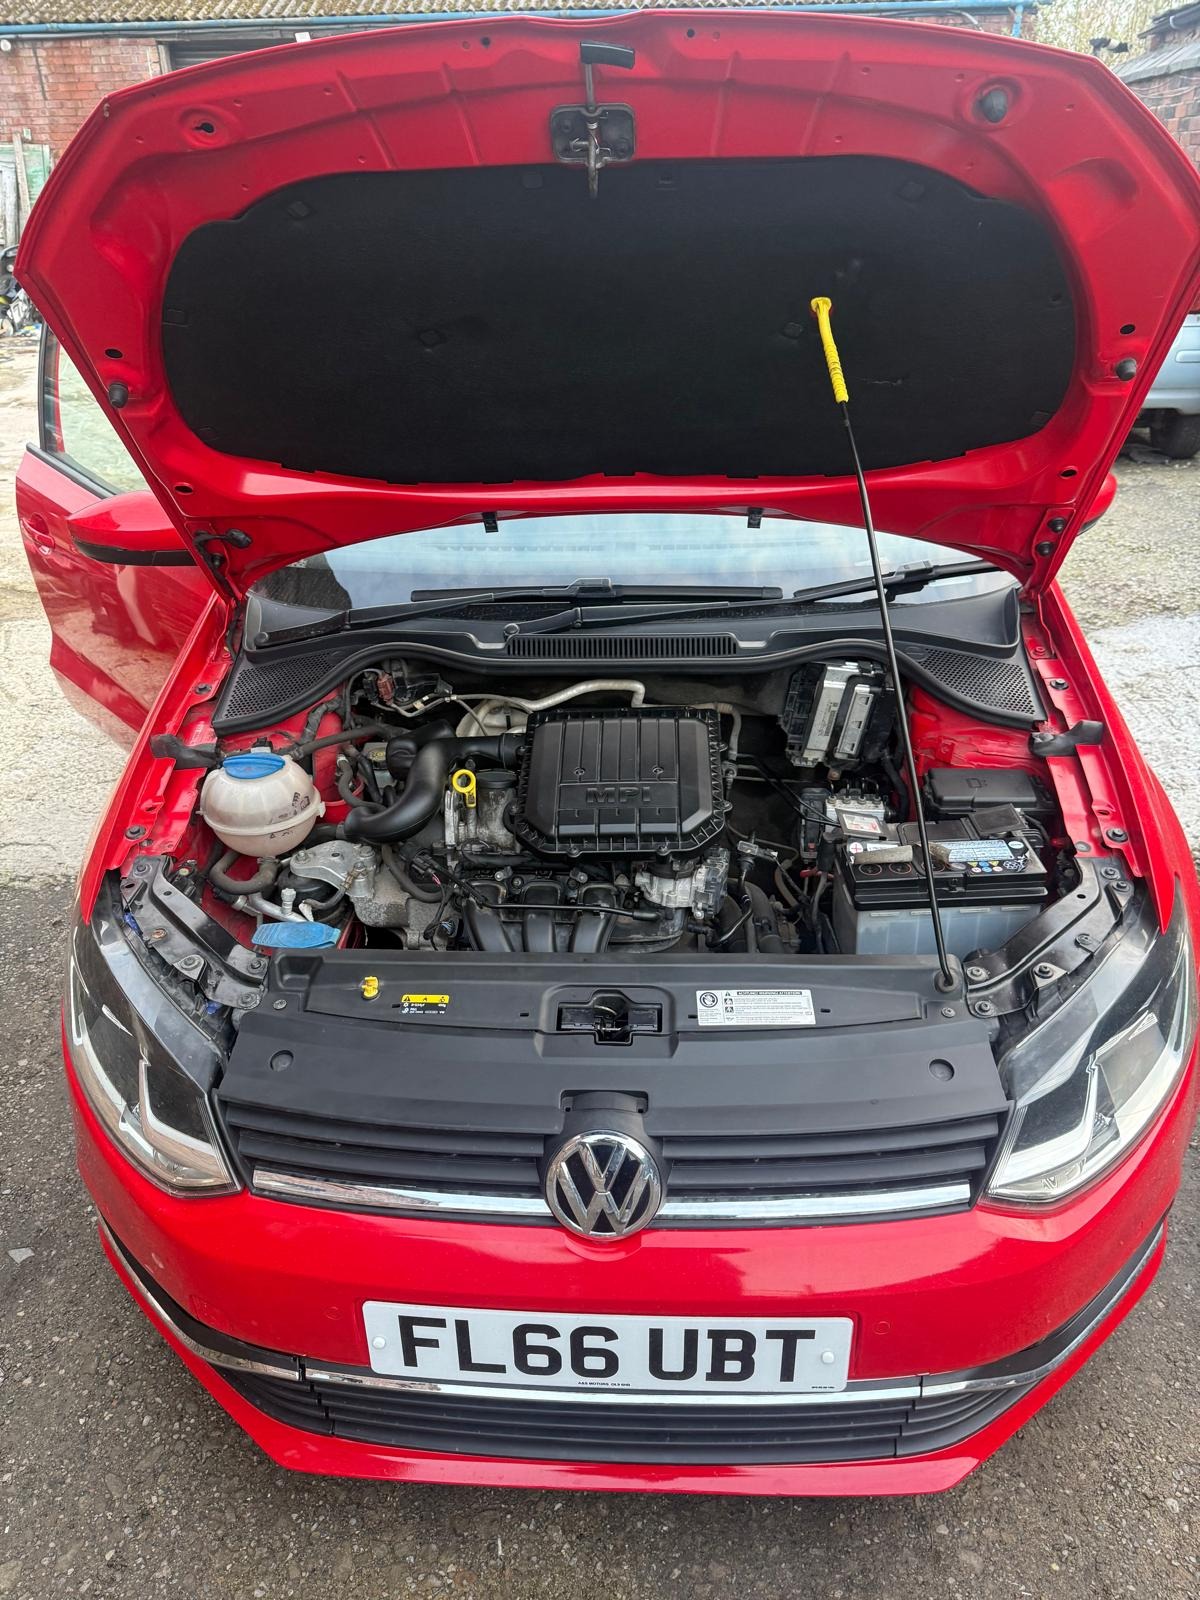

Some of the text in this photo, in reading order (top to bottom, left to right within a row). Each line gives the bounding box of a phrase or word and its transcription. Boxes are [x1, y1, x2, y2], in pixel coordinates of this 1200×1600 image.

[586, 786, 651, 803] MPI
[397, 1314, 816, 1383] FL66 UBT
